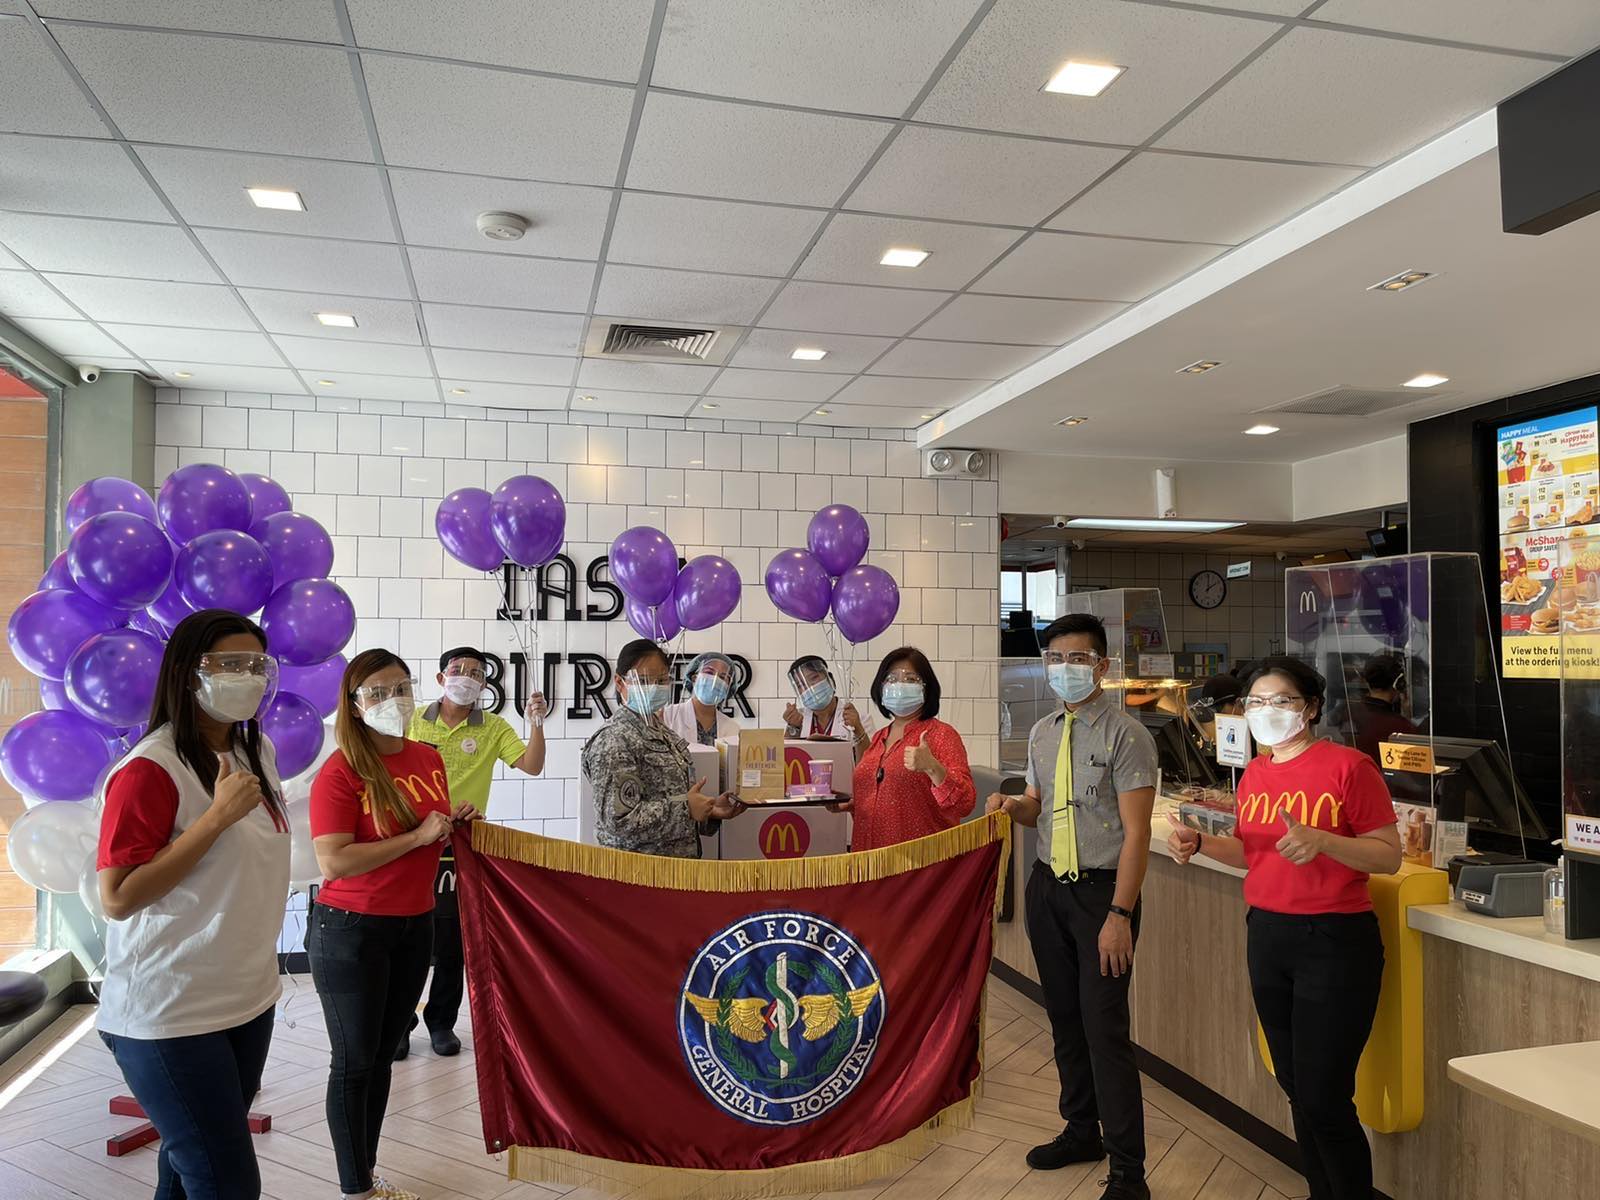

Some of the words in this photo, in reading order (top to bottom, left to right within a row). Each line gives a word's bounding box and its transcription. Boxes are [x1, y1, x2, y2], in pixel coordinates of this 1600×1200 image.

[1501, 430, 1521, 439] HAPPY
[1521, 426, 1539, 435] MEAL
[1511, 646, 1532, 655] View
[1533, 646, 1548, 655] the
[1566, 647, 1593, 655] menu
[1505, 658, 1514, 666] at
[1516, 657, 1530, 666] the
[1571, 657, 1600, 666] kiosk!
[1576, 822, 1591, 834] WE
[706, 929, 752, 971] AIR
[764, 920, 855, 965] FORCE
[691, 1045, 769, 1118] GENERAL
[791, 1038, 874, 1119] HOSPITAL
